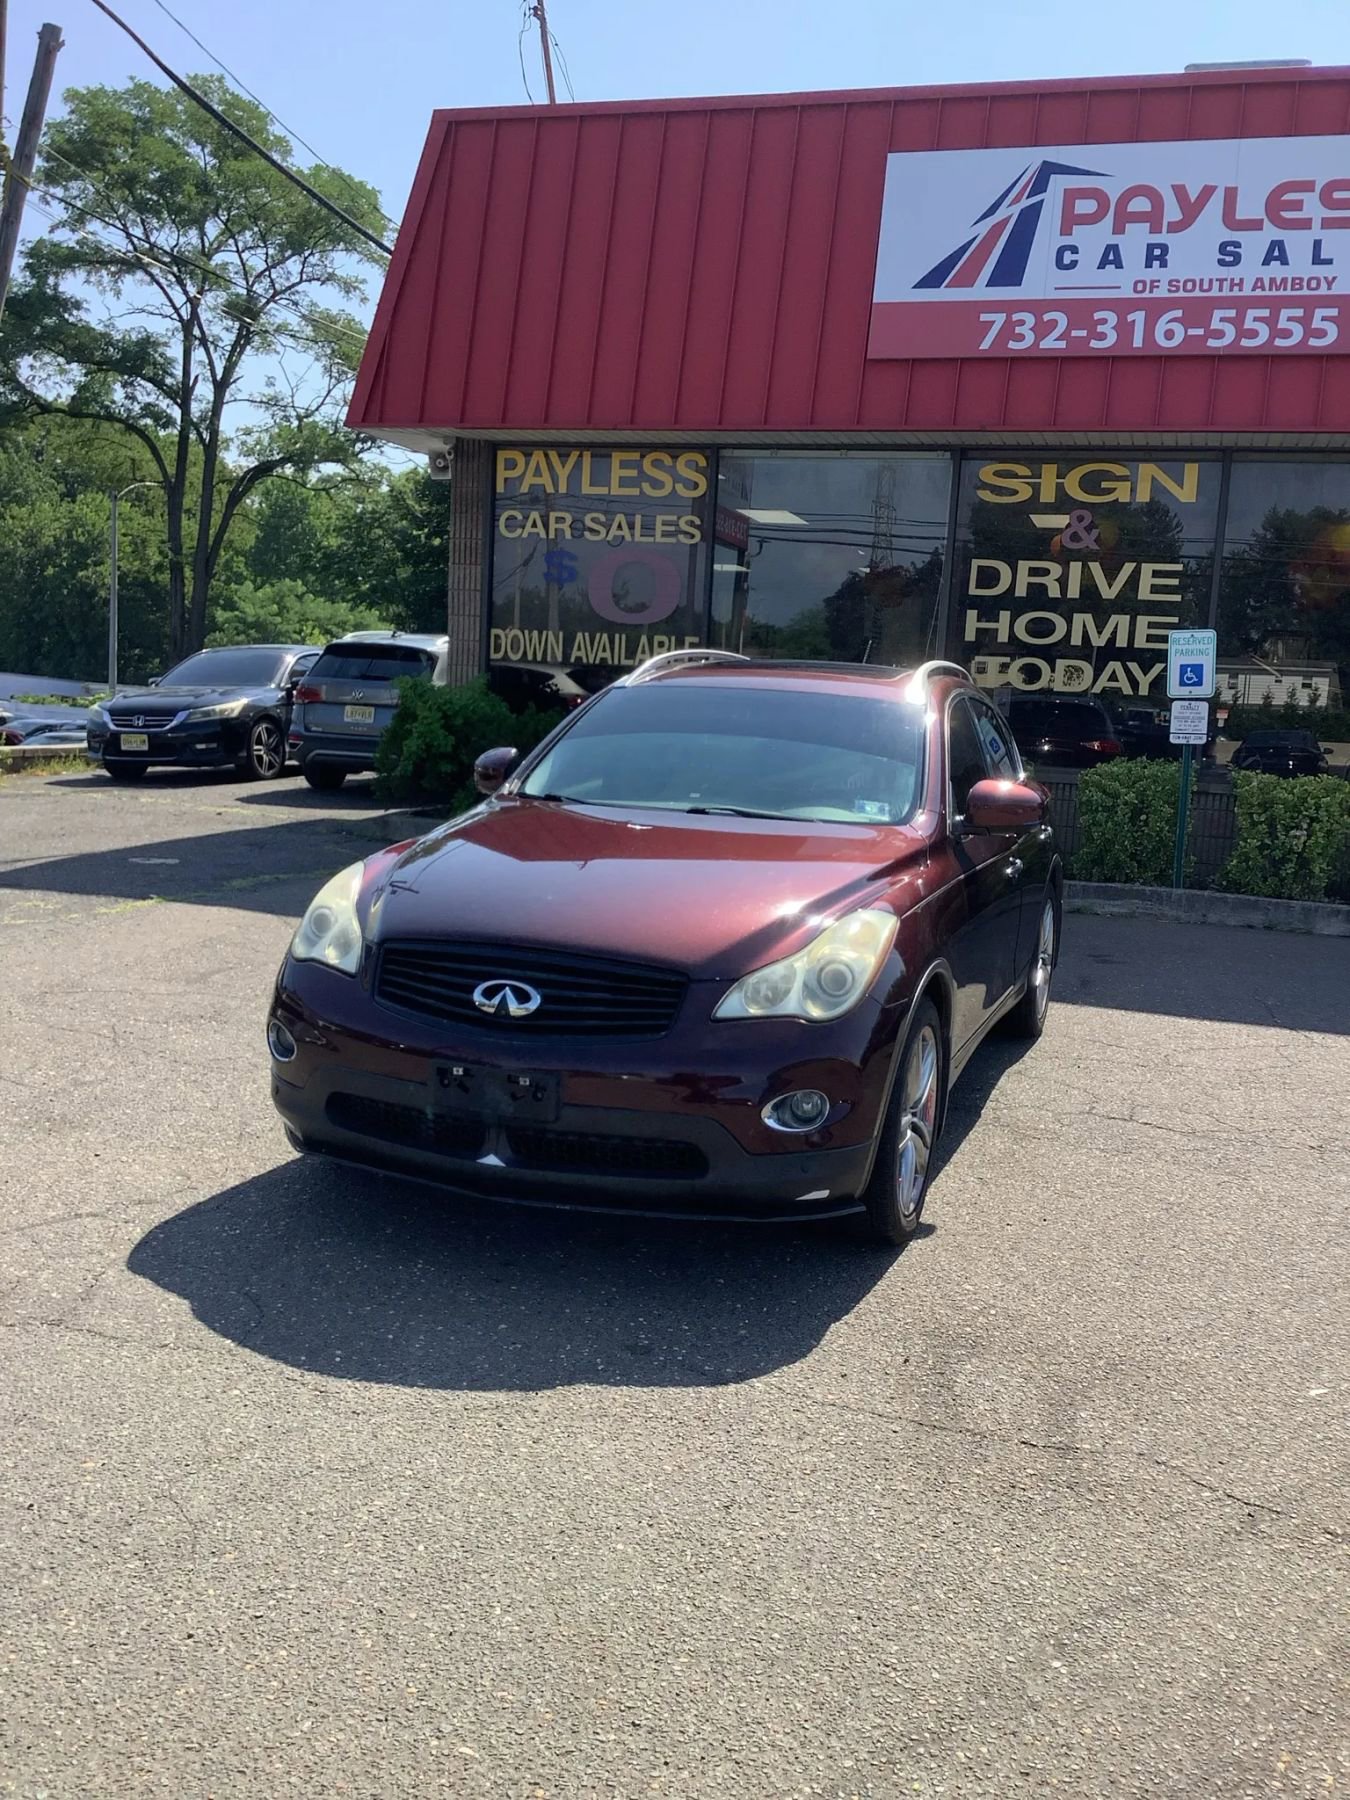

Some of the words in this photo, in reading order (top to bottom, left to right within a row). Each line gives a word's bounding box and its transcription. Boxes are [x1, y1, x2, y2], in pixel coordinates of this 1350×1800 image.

[1054, 242, 1169, 270] CAR
[1217, 238, 1335, 268] SAL
[1132, 279, 1161, 294] OF
[1167, 277, 1244, 293] SOUTH
[1251, 275, 1338, 292] AMBOY
[978, 307, 1340, 350] 732-316-5555
[495, 450, 708, 498] PAYLESS
[976, 463, 1199, 504] SIGN
[499, 510, 572, 539] CAR
[584, 513, 702, 544] SALES
[1062, 509, 1100, 550] &
[968, 558, 1184, 602] DRIVE
[490, 628, 564, 662] DOWN
[964, 609, 1180, 650] HOME
[1172, 637, 1212, 645] RESERVED
[1175, 648, 1210, 657] PARKING
[974, 656, 1167, 696] TODAY
